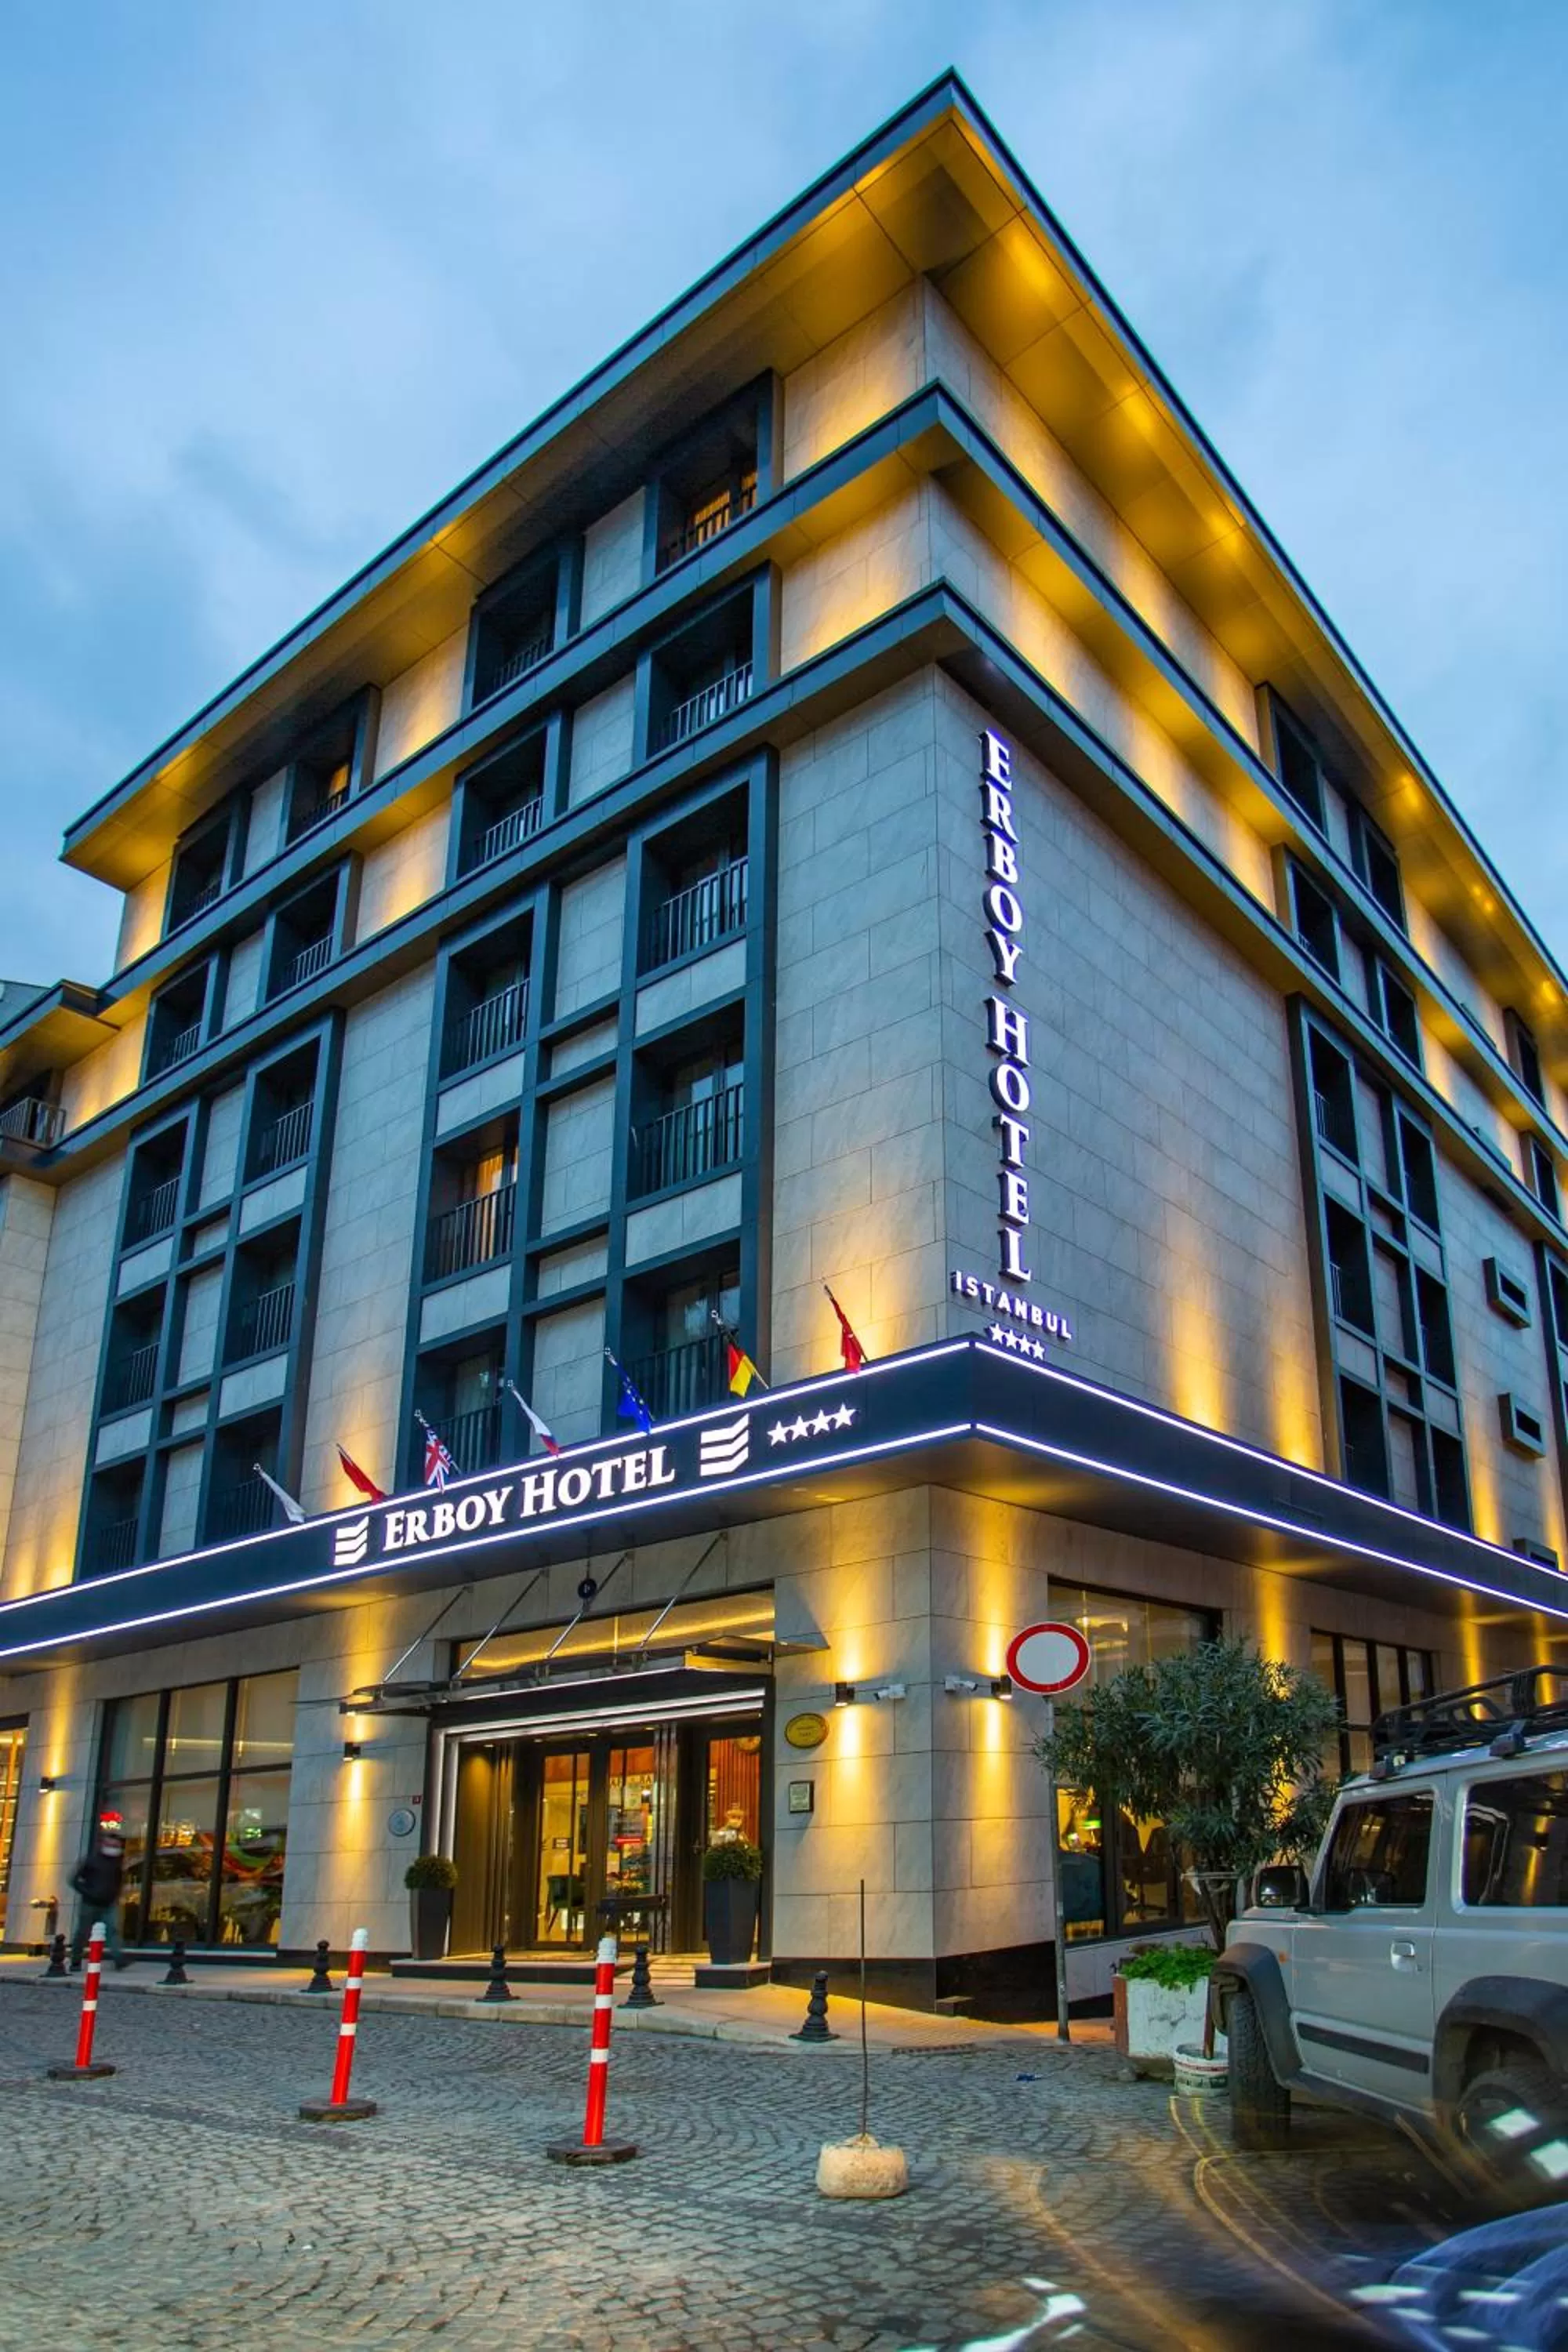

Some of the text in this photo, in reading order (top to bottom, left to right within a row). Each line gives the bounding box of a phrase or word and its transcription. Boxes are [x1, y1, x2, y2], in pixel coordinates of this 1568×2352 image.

[983, 727, 1032, 1283] ERBOY HOTEL
[953, 1269, 1073, 1340] ISTANBUL
[382, 1445, 676, 1552] ERBOY HOTEL
